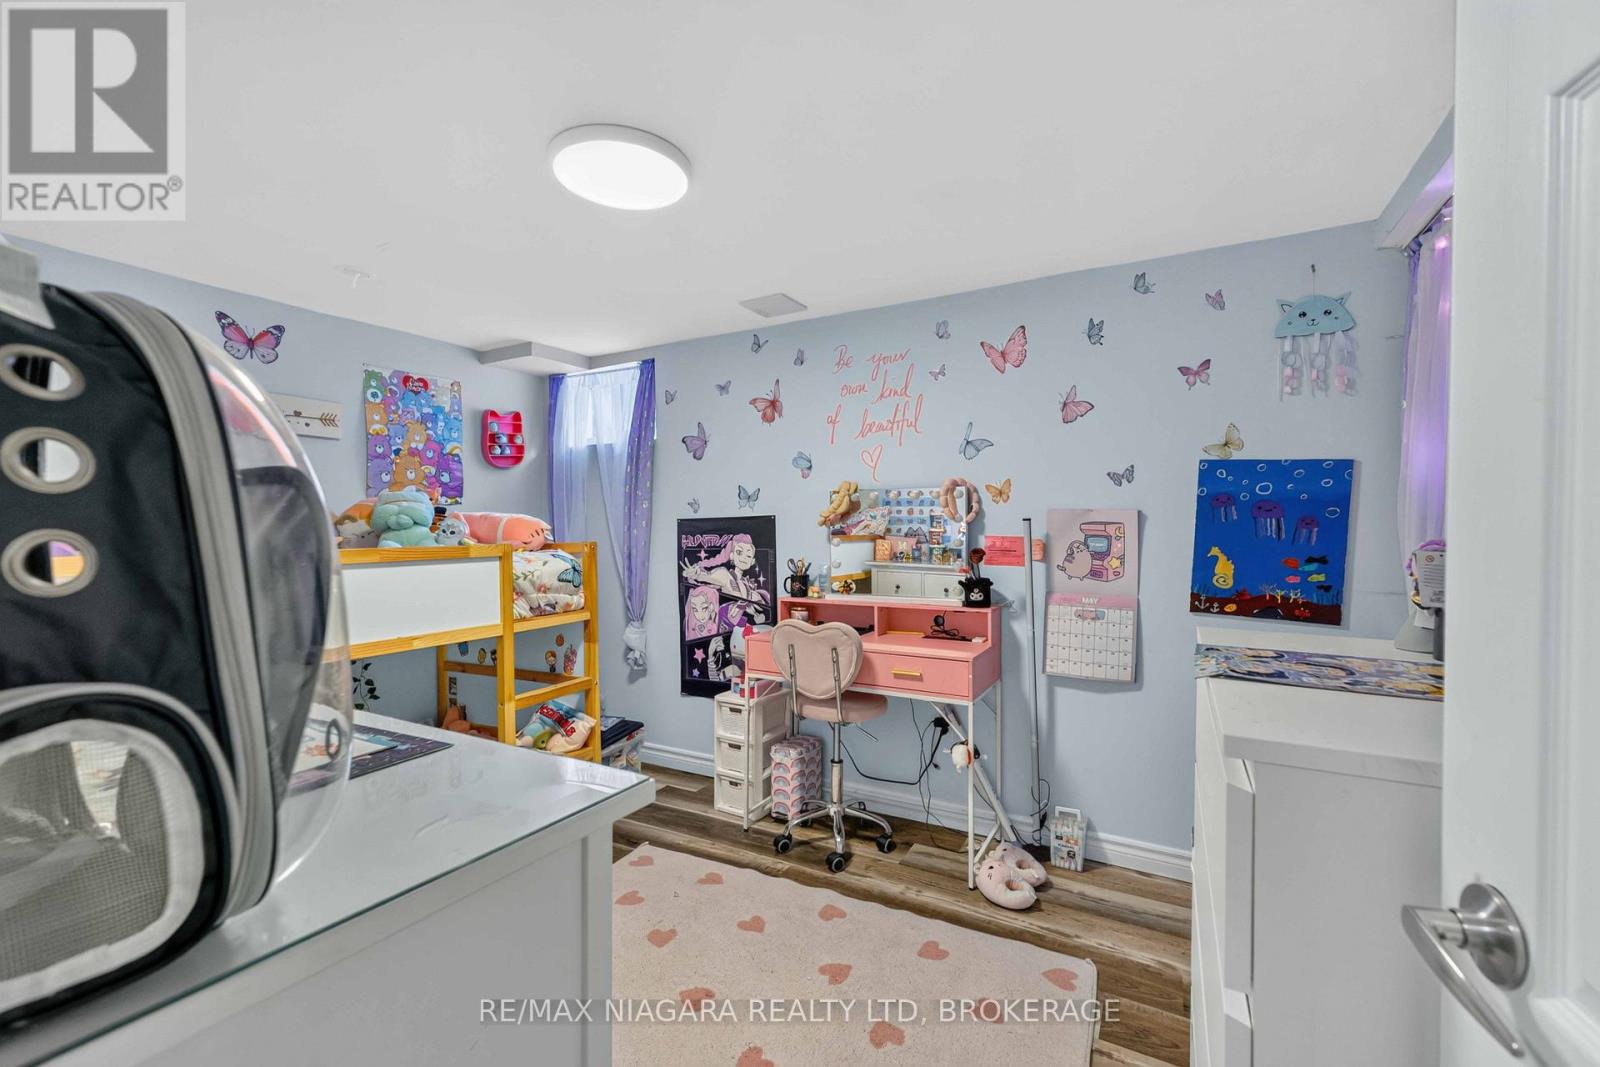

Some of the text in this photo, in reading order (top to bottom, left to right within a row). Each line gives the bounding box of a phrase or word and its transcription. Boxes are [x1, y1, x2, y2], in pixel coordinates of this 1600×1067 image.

[832, 345, 911, 381] Be your
[840, 363, 914, 404] own kind
[826, 393, 923, 447] of beautiful
[1081, 596, 1099, 605] MAY
